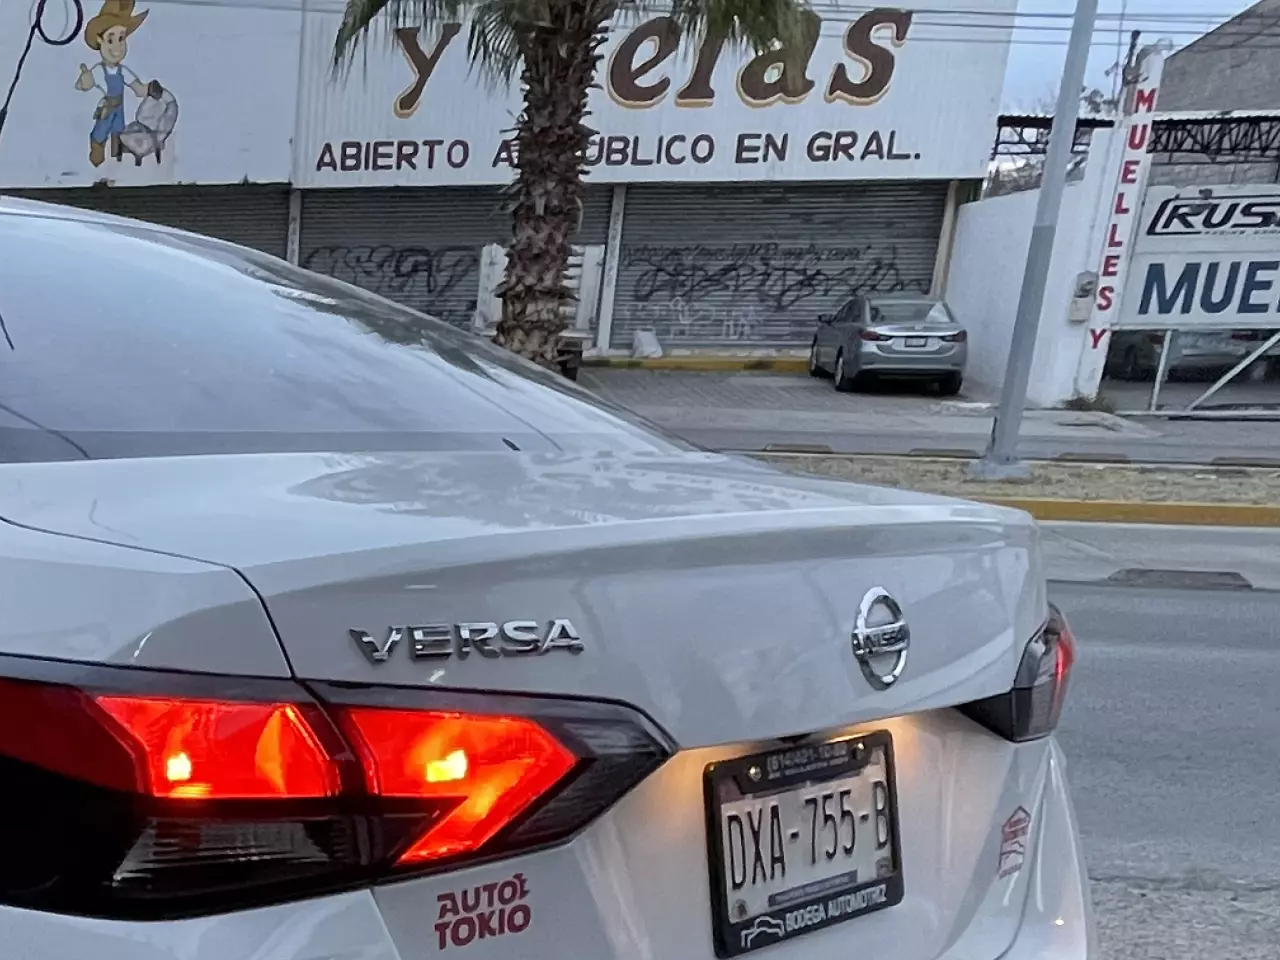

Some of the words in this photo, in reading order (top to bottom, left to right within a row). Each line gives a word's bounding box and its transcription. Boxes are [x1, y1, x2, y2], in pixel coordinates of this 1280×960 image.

[606, 8, 914, 109] elas
[316, 139, 470, 172] ABIERTO
[491, 139, 520, 168] A
[583, 133, 715, 167] UBLICO
[735, 132, 790, 164] EN
[806, 130, 922, 162] GRAL.
[1096, 87, 1157, 311] MUELLES
[1161, 202, 1280, 229] RUS
[1137, 260, 1280, 315] MUE
[1089, 328, 1109, 350] Y
[349, 618, 585, 664] VERSA
[725, 779, 890, 891] DXA-755-B
[434, 904, 531, 951] TOKIO
[785, 902, 827, 932] BODEGA
